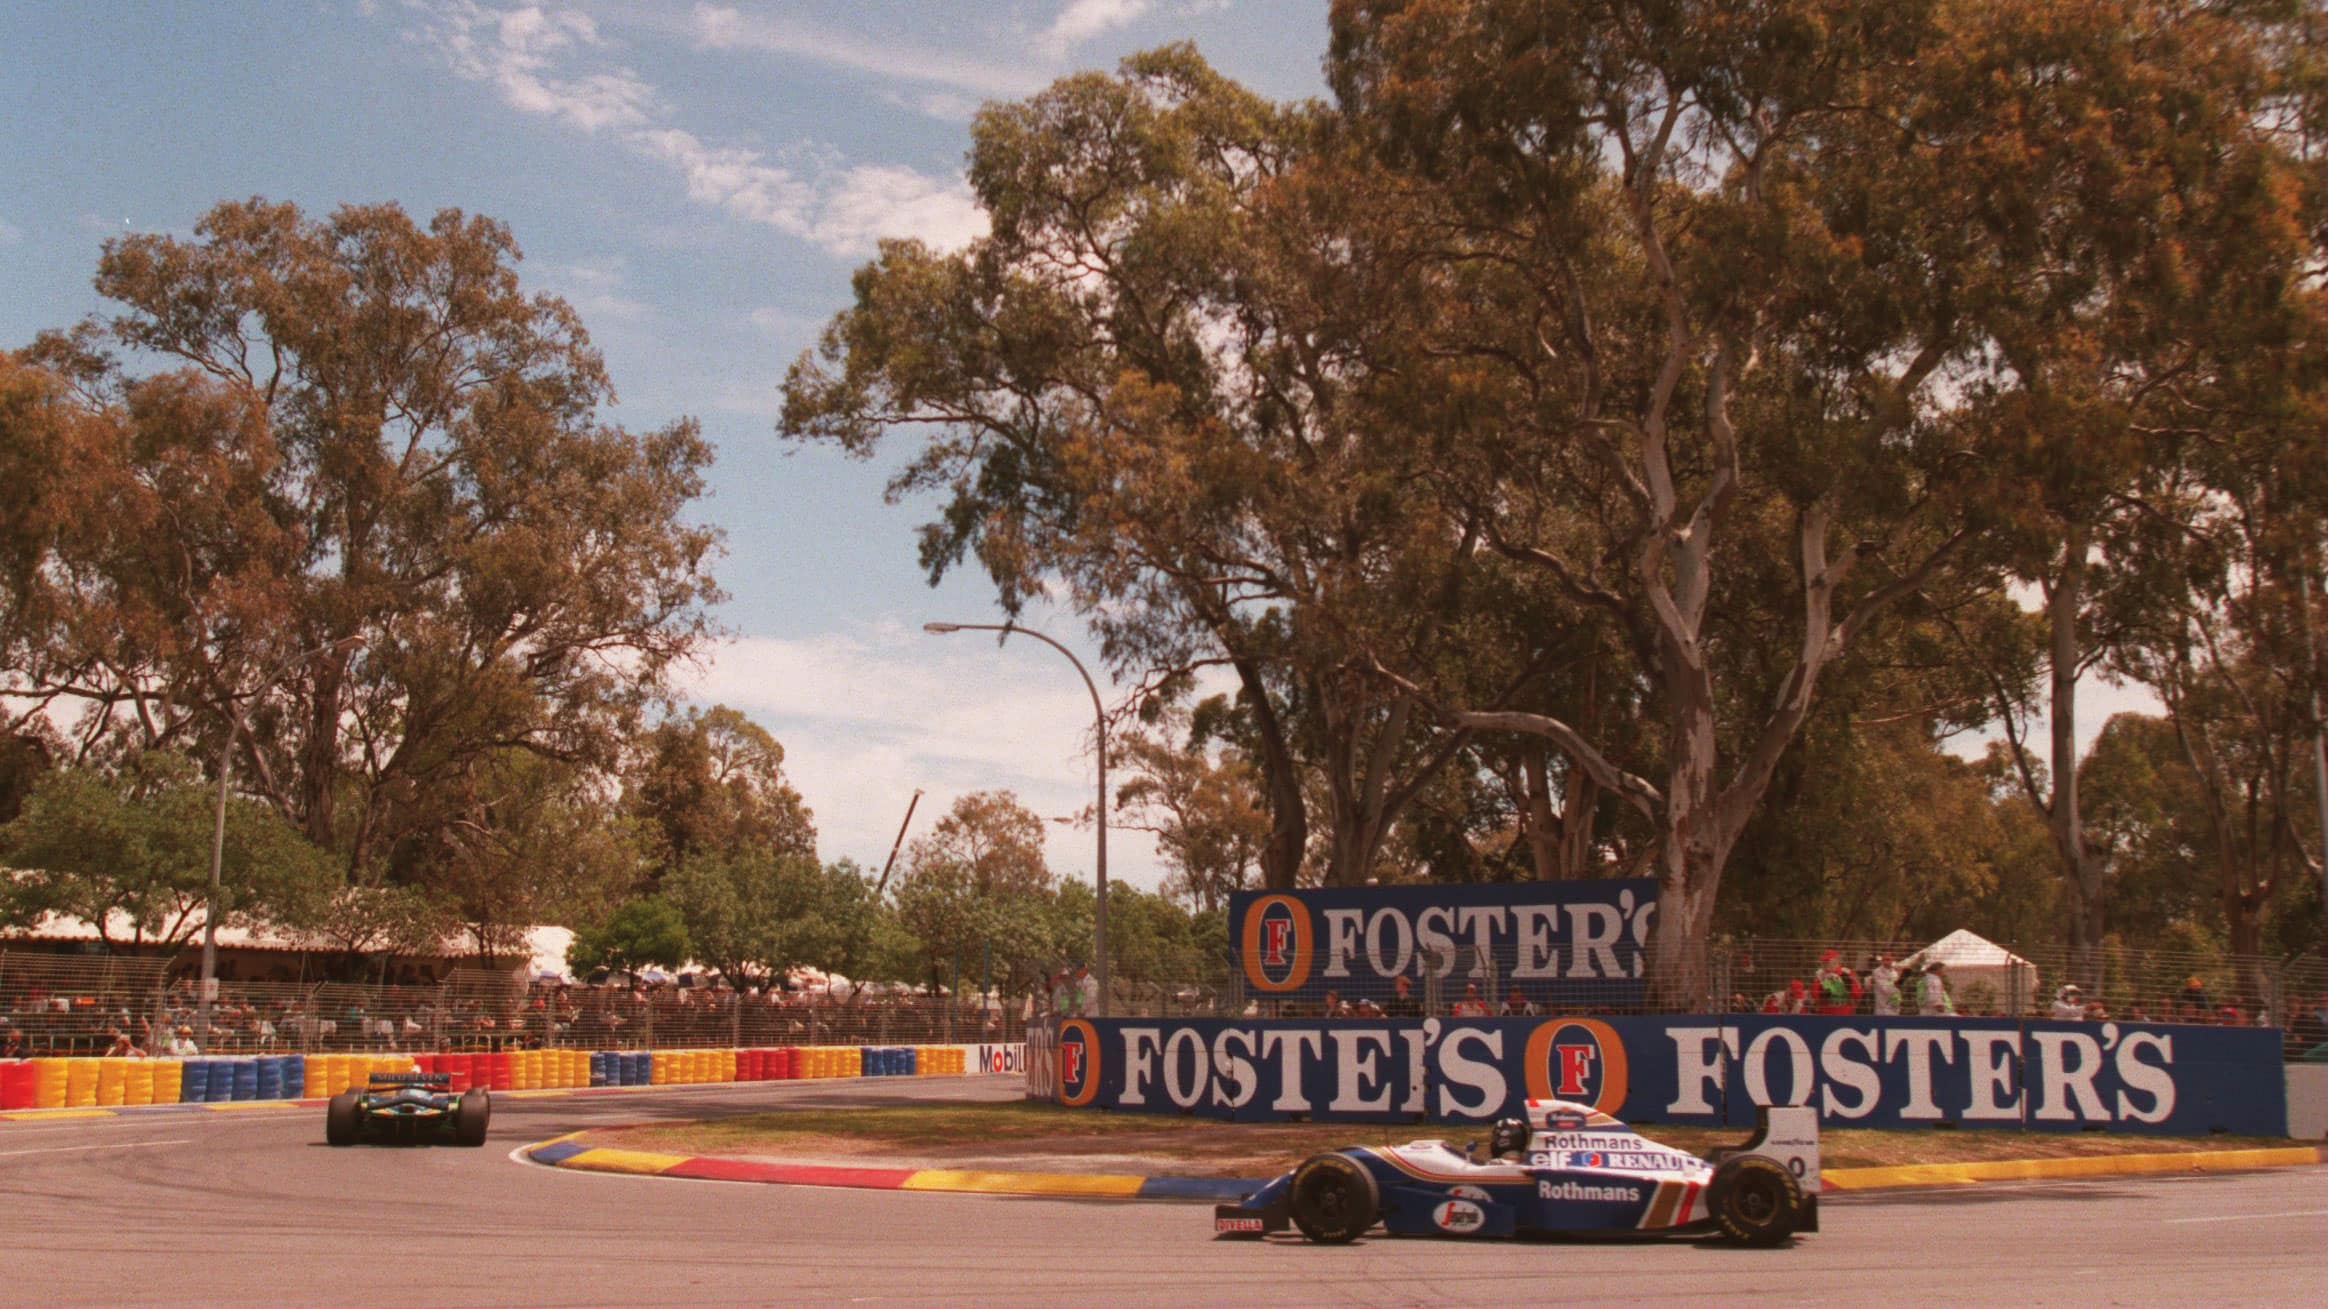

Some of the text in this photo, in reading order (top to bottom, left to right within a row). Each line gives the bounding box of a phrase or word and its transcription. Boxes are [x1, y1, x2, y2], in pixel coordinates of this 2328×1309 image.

[1264, 918, 1292, 966] F
[1063, 1042, 1083, 1083] F
[1555, 1044, 1597, 1097] F
[1665, 1023, 2175, 1124] FOSTER'S
[1545, 1134, 1643, 1151] Rothmans
[1530, 1151, 1572, 1169] elf
[1538, 1180, 1641, 1201] Rothmans
